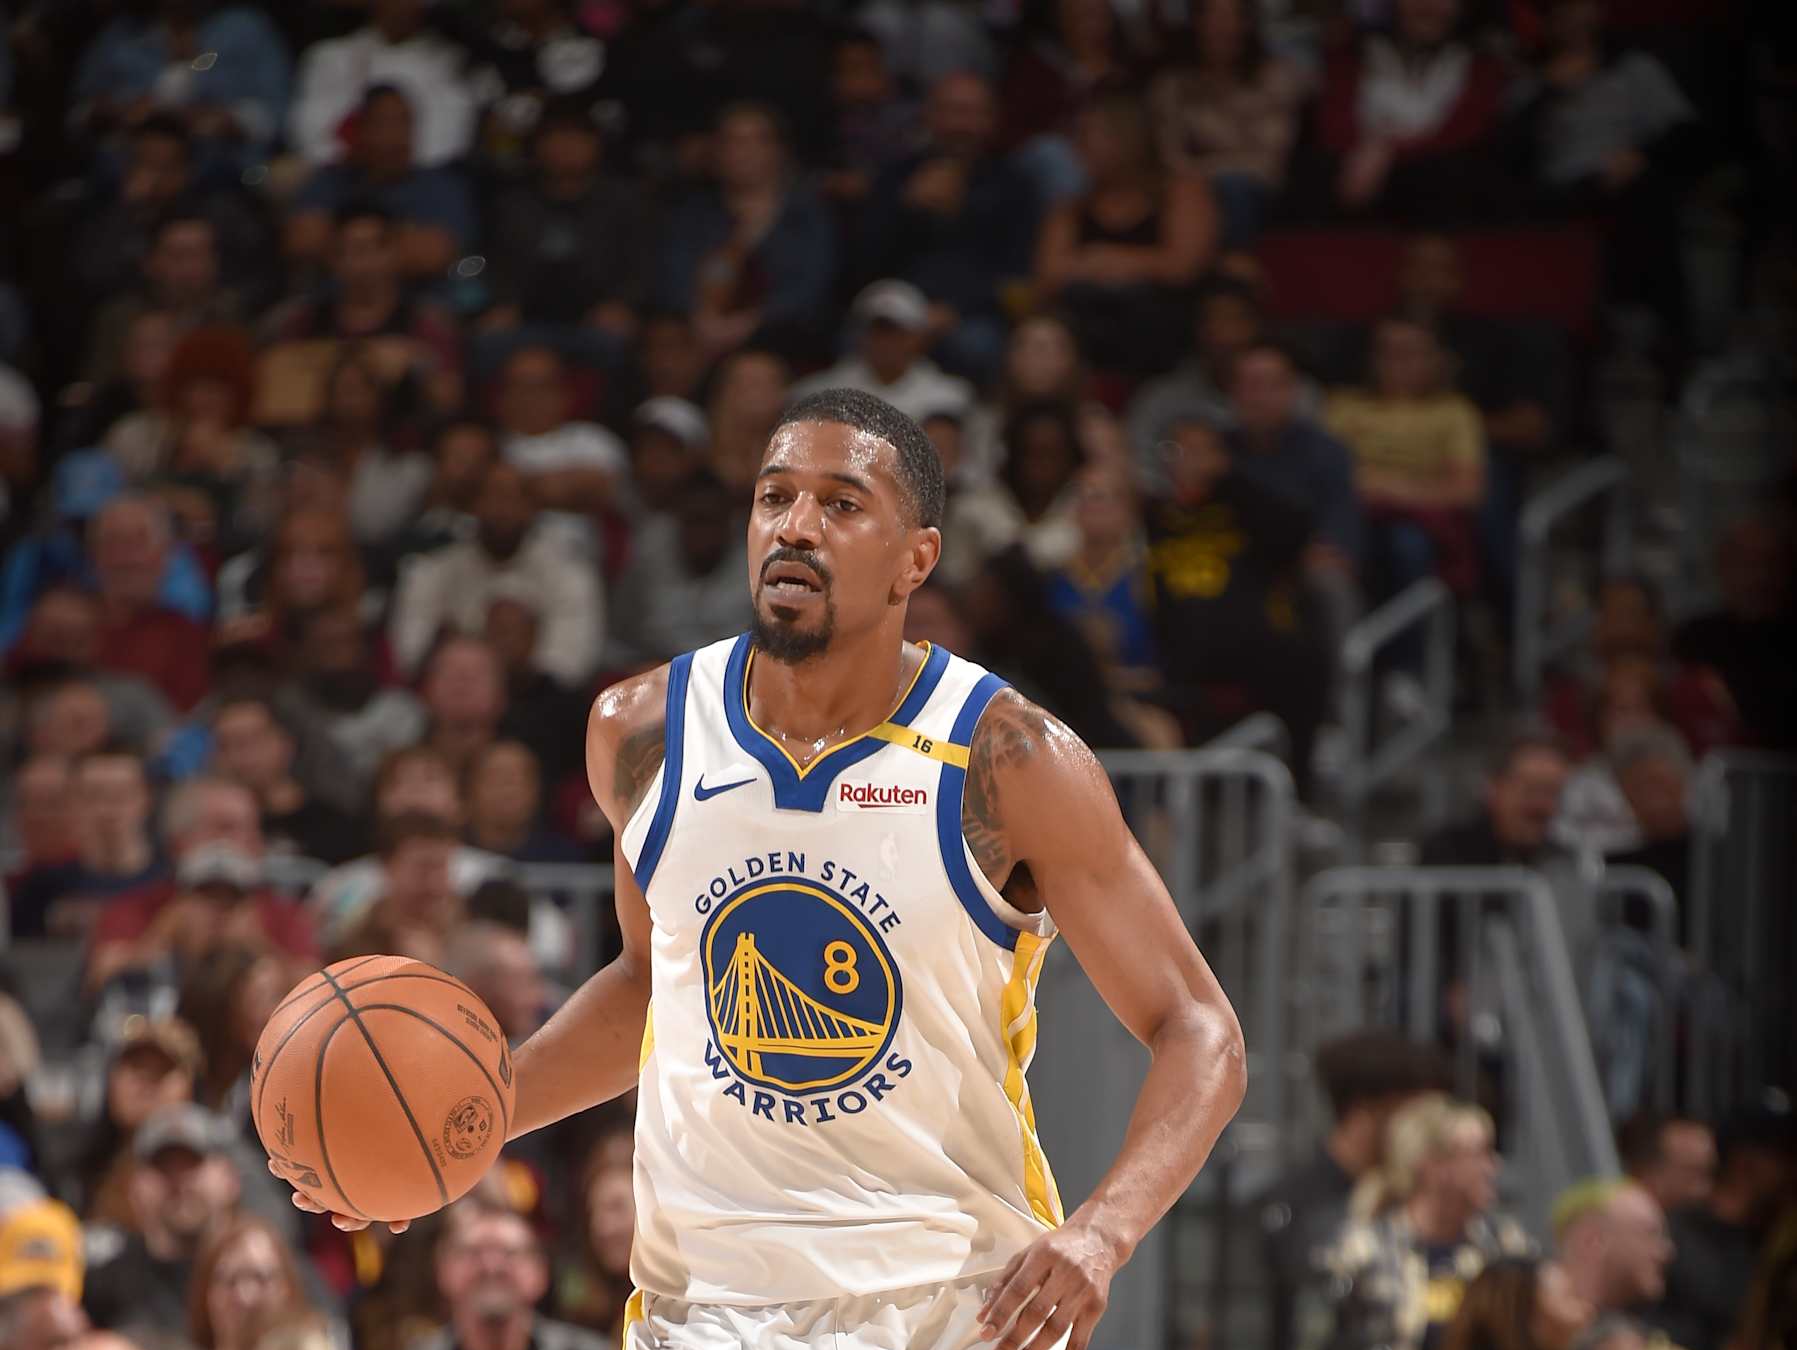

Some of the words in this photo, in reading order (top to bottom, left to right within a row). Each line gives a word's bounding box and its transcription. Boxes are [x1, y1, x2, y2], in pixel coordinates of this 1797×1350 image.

[911, 735, 933, 754] 16
[840, 783, 927, 806] Rakuten
[695, 852, 806, 914] GOLDEN
[820, 861, 901, 933] STATE
[823, 939, 861, 995] 8
[704, 1038, 913, 1126] WARRIORS
